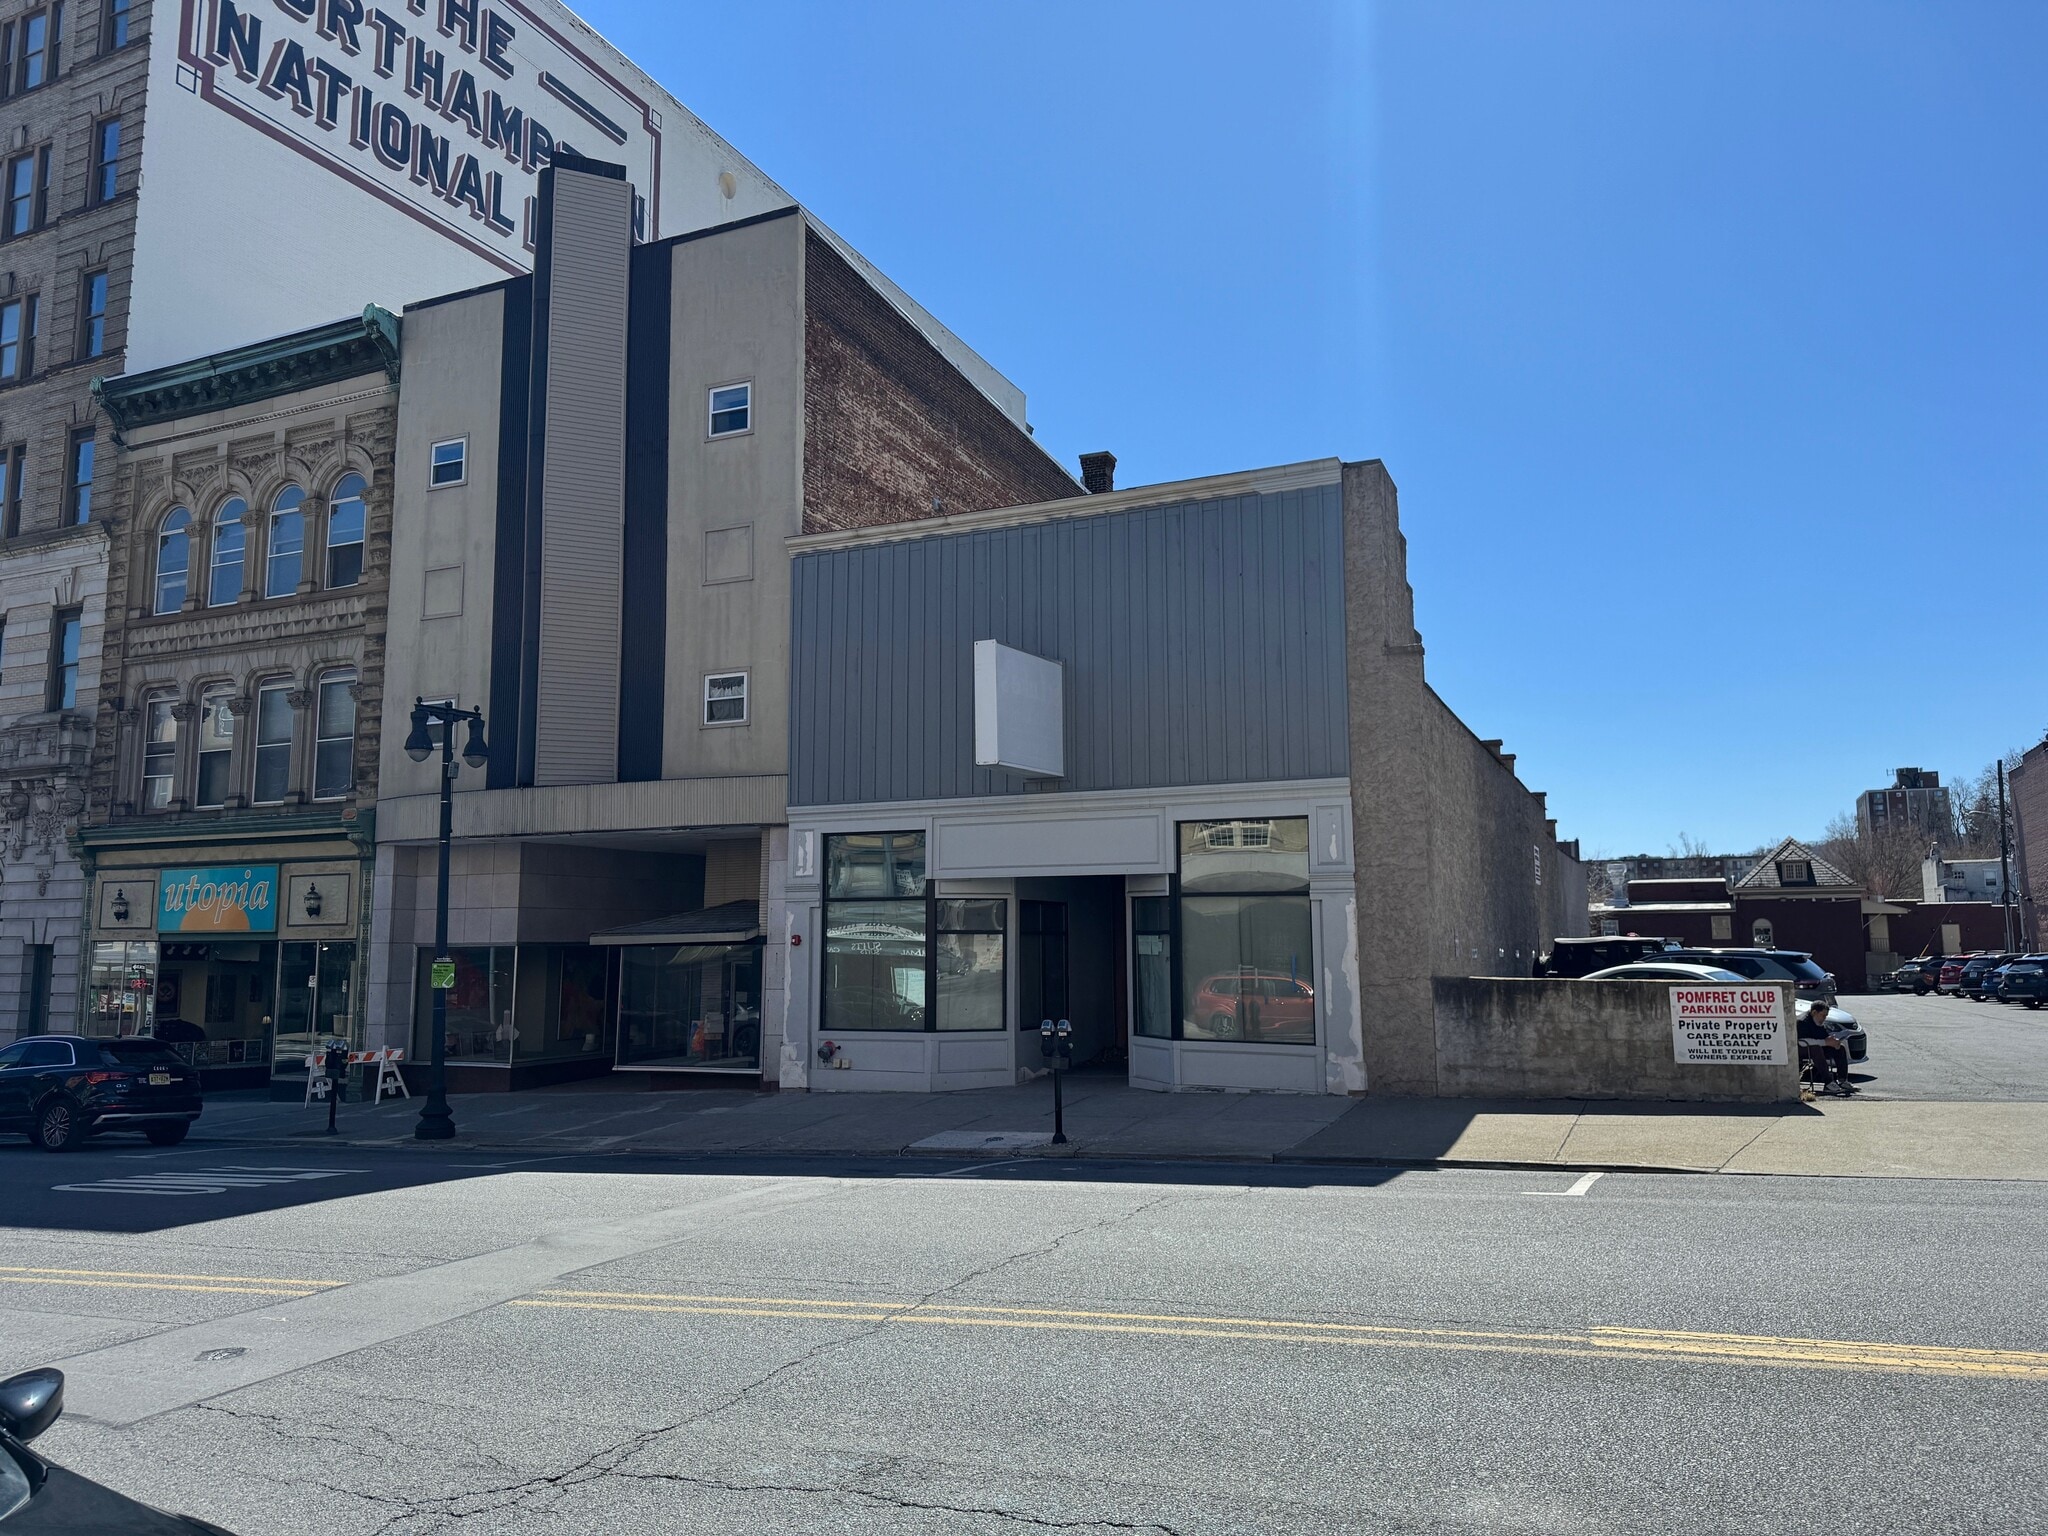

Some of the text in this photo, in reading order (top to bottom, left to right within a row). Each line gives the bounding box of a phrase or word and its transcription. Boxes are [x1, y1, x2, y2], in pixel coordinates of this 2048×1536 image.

[406, 0, 516, 80] HE
[272, 0, 587, 175] RTHAMP
[204, 0, 515, 238] NATIONAL
[164, 869, 270, 924] utopia
[1676, 991, 1776, 1003] POMFRET CLUB
[1681, 1005, 1772, 1014] PARKING ONLY
[1678, 1020, 1778, 1032] Private Property
